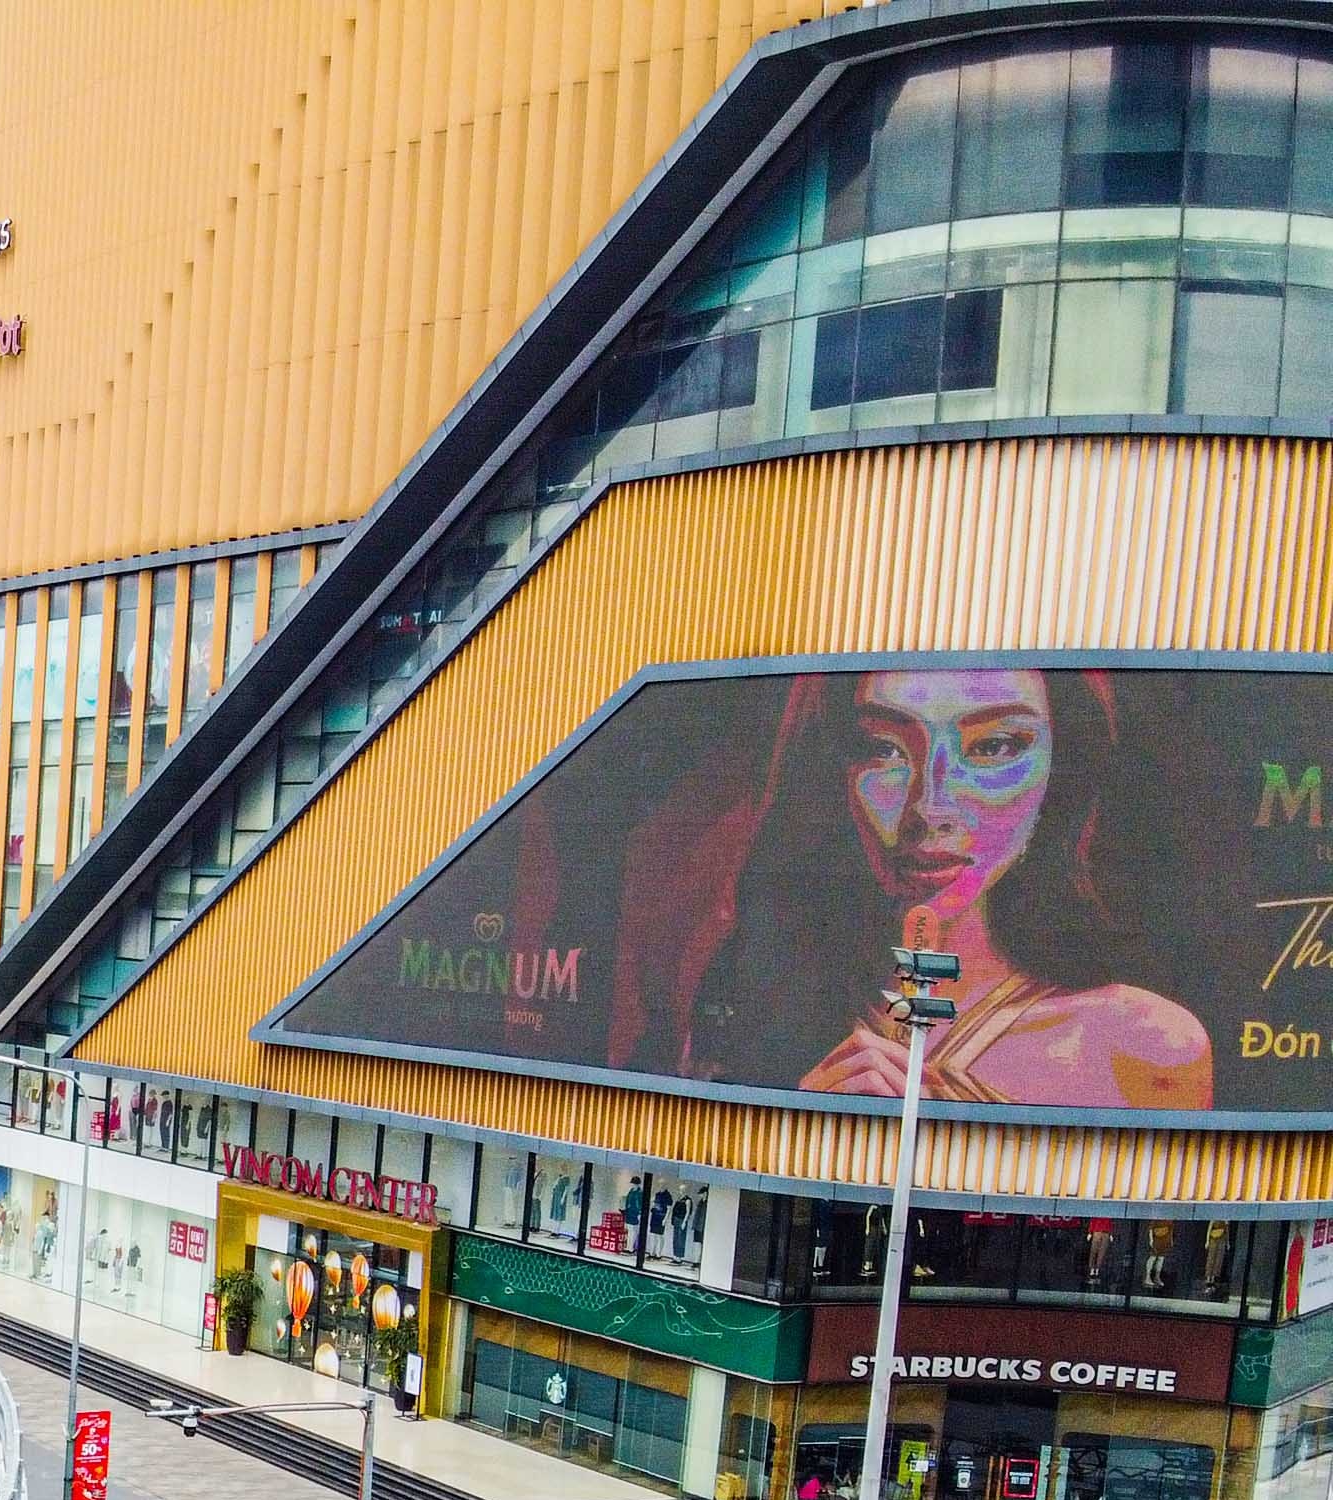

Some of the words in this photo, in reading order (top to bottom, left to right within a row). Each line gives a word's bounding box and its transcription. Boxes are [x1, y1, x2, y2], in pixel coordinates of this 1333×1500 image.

[399, 937, 582, 1001] MAGNUM
[1239, 1021, 1321, 1058] Đón
[221, 1141, 323, 1200] VINCOM
[329, 1166, 438, 1229] CENTER
[1049, 1361, 1176, 1393] COFFEE
